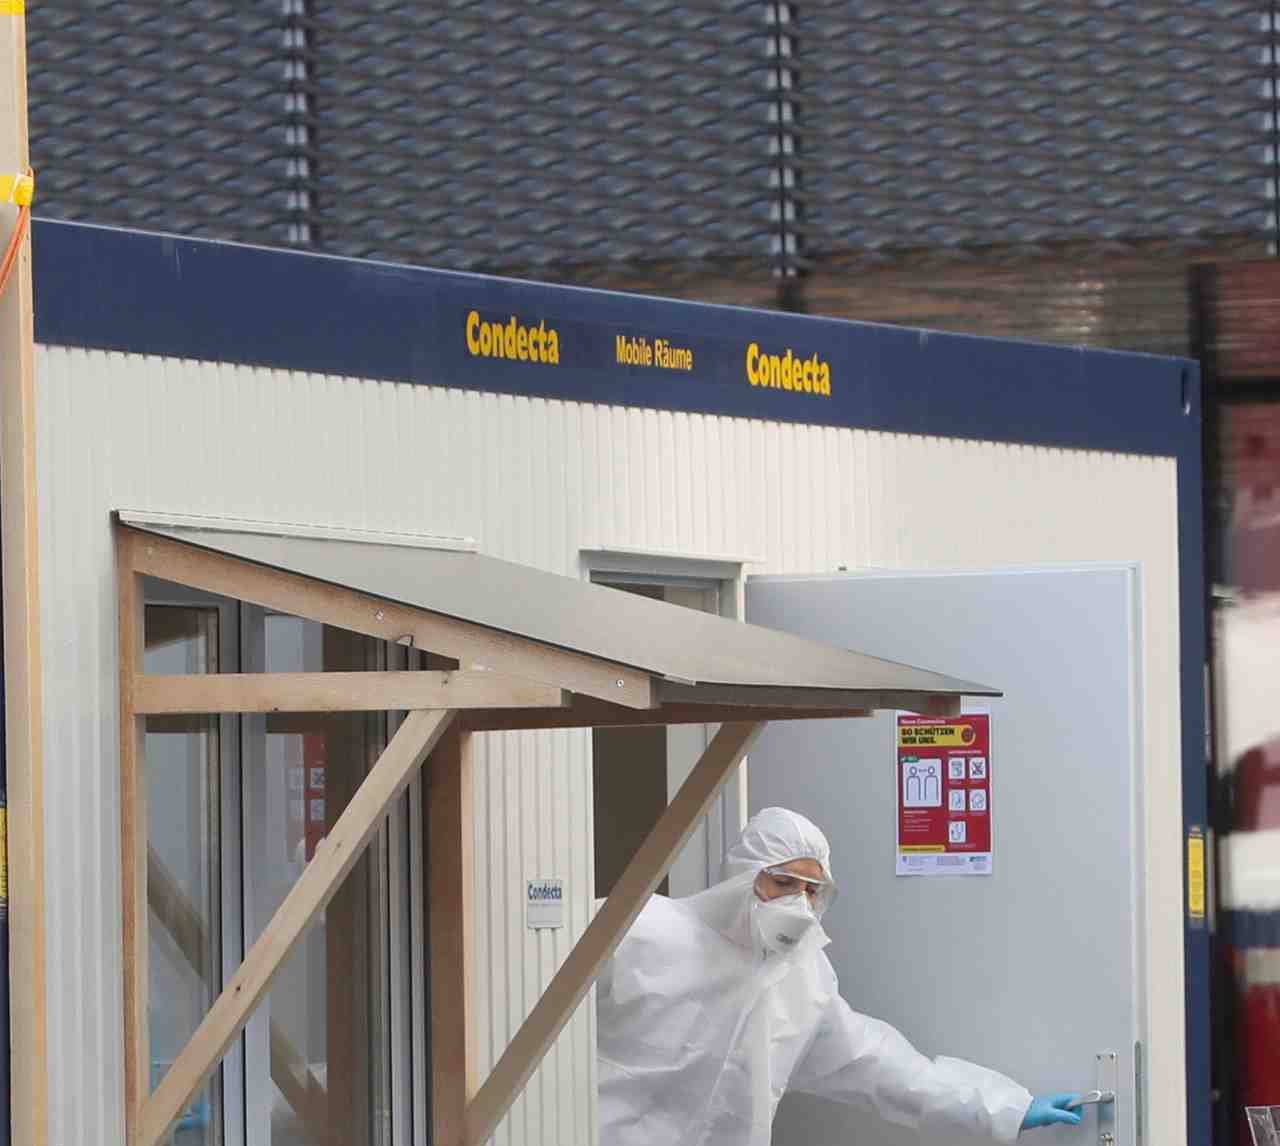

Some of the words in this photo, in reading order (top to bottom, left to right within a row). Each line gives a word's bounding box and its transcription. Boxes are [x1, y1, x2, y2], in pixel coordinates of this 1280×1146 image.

[466, 311, 560, 365] Condecta
[616, 335, 651, 367] Mobile
[654, 338, 693, 371] Räume
[746, 343, 832, 396] Condecta
